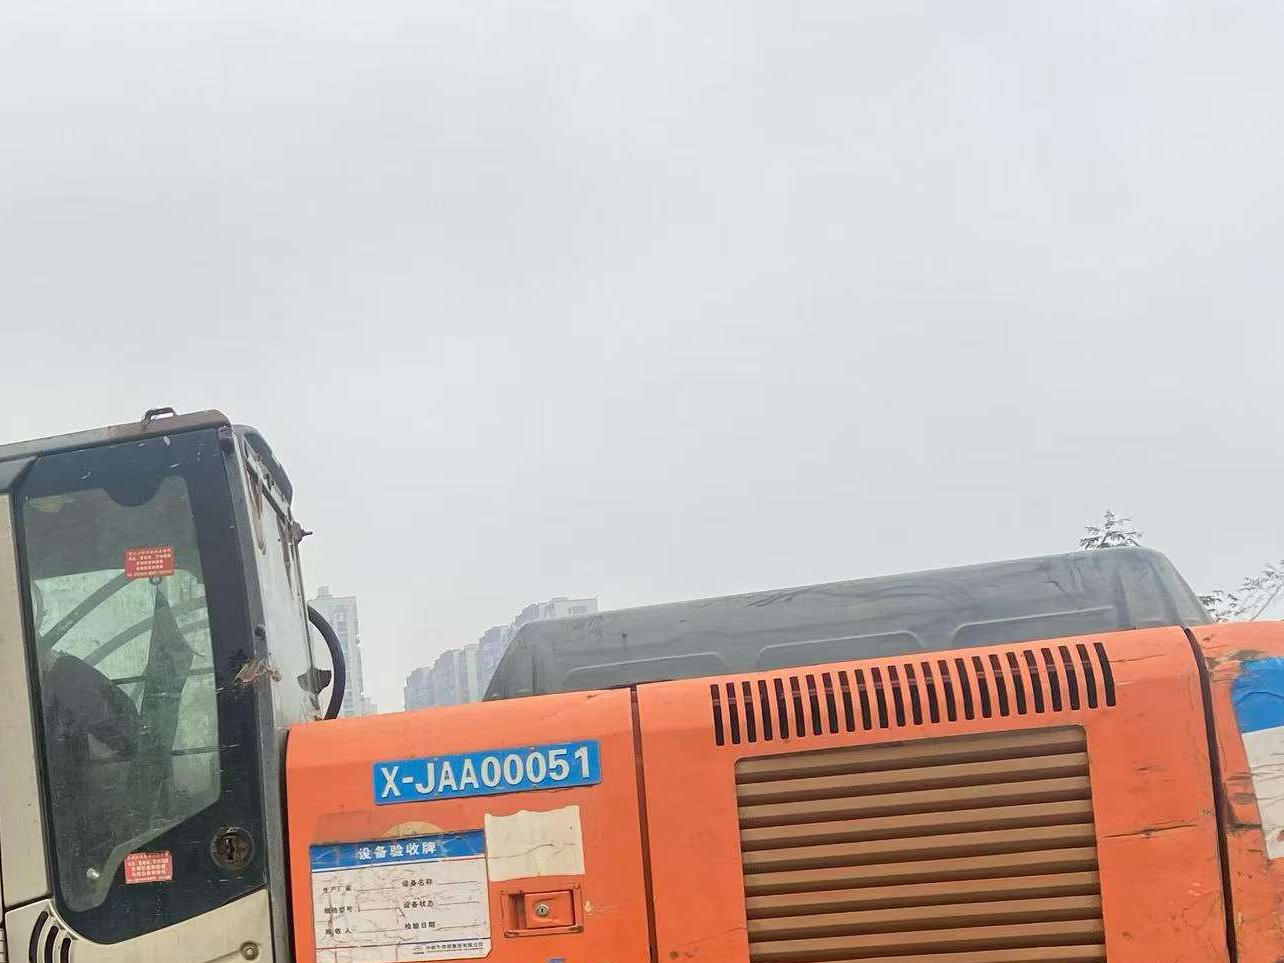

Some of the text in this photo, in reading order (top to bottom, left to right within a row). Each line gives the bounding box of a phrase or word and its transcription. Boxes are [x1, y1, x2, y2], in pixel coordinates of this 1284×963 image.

[380, 746, 592, 799] X-JAA00051
[356, 841, 437, 861] 设备验收牌
